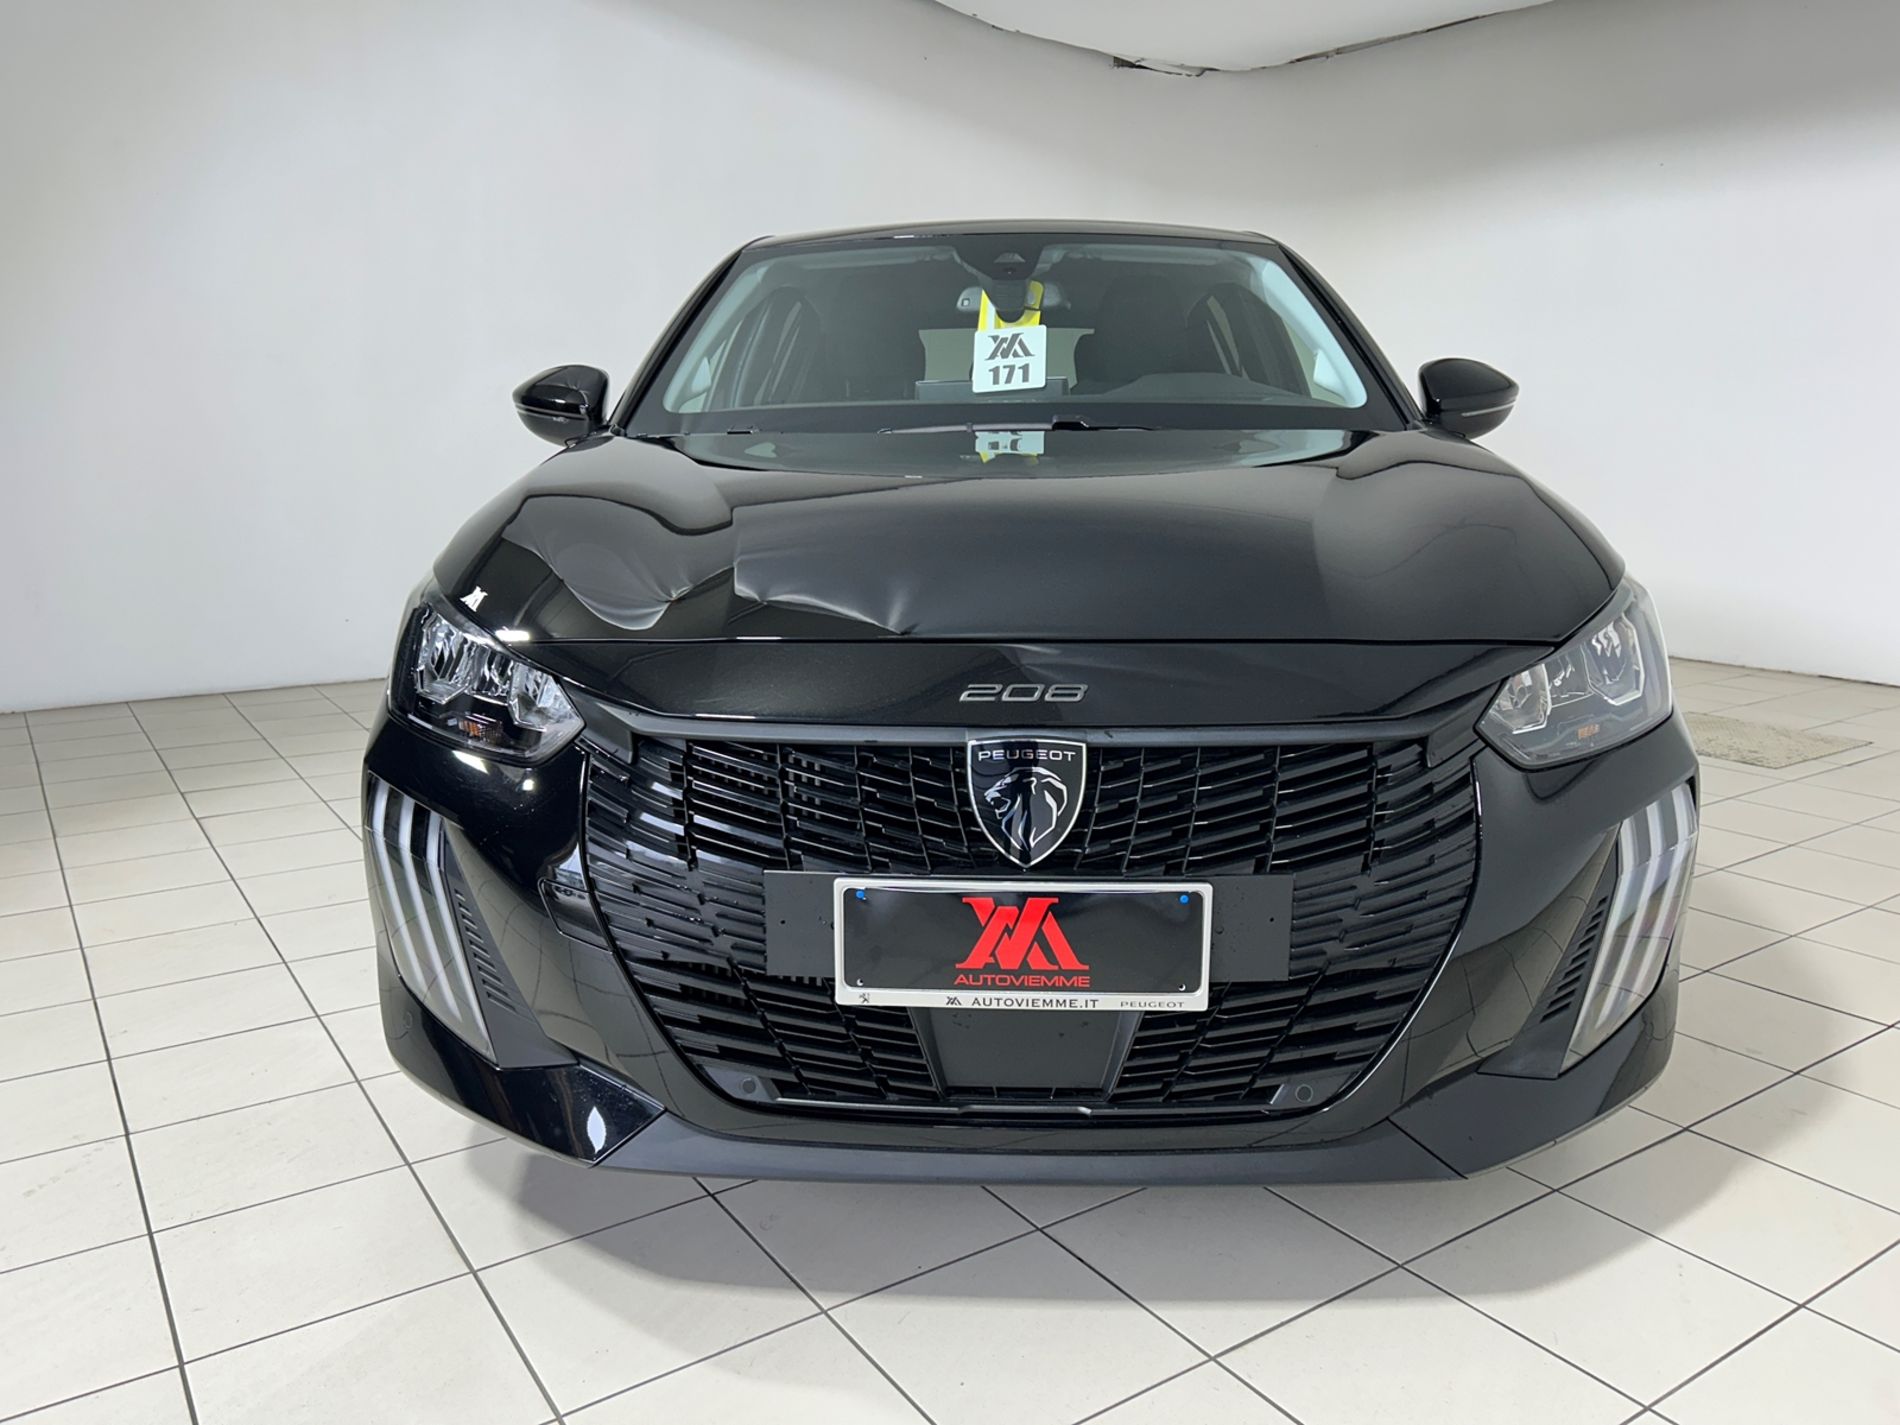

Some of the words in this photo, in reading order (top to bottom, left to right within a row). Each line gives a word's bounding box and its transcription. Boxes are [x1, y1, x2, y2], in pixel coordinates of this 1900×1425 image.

[988, 363, 1031, 386] 171
[959, 684, 1088, 702] 208
[978, 750, 1076, 761] PEUGEOT
[954, 974, 1090, 988] AUTOVIEMME
[972, 997, 1099, 1009] AUTOVIEMME.IT
[1120, 1000, 1185, 1009] PEUGEOT
